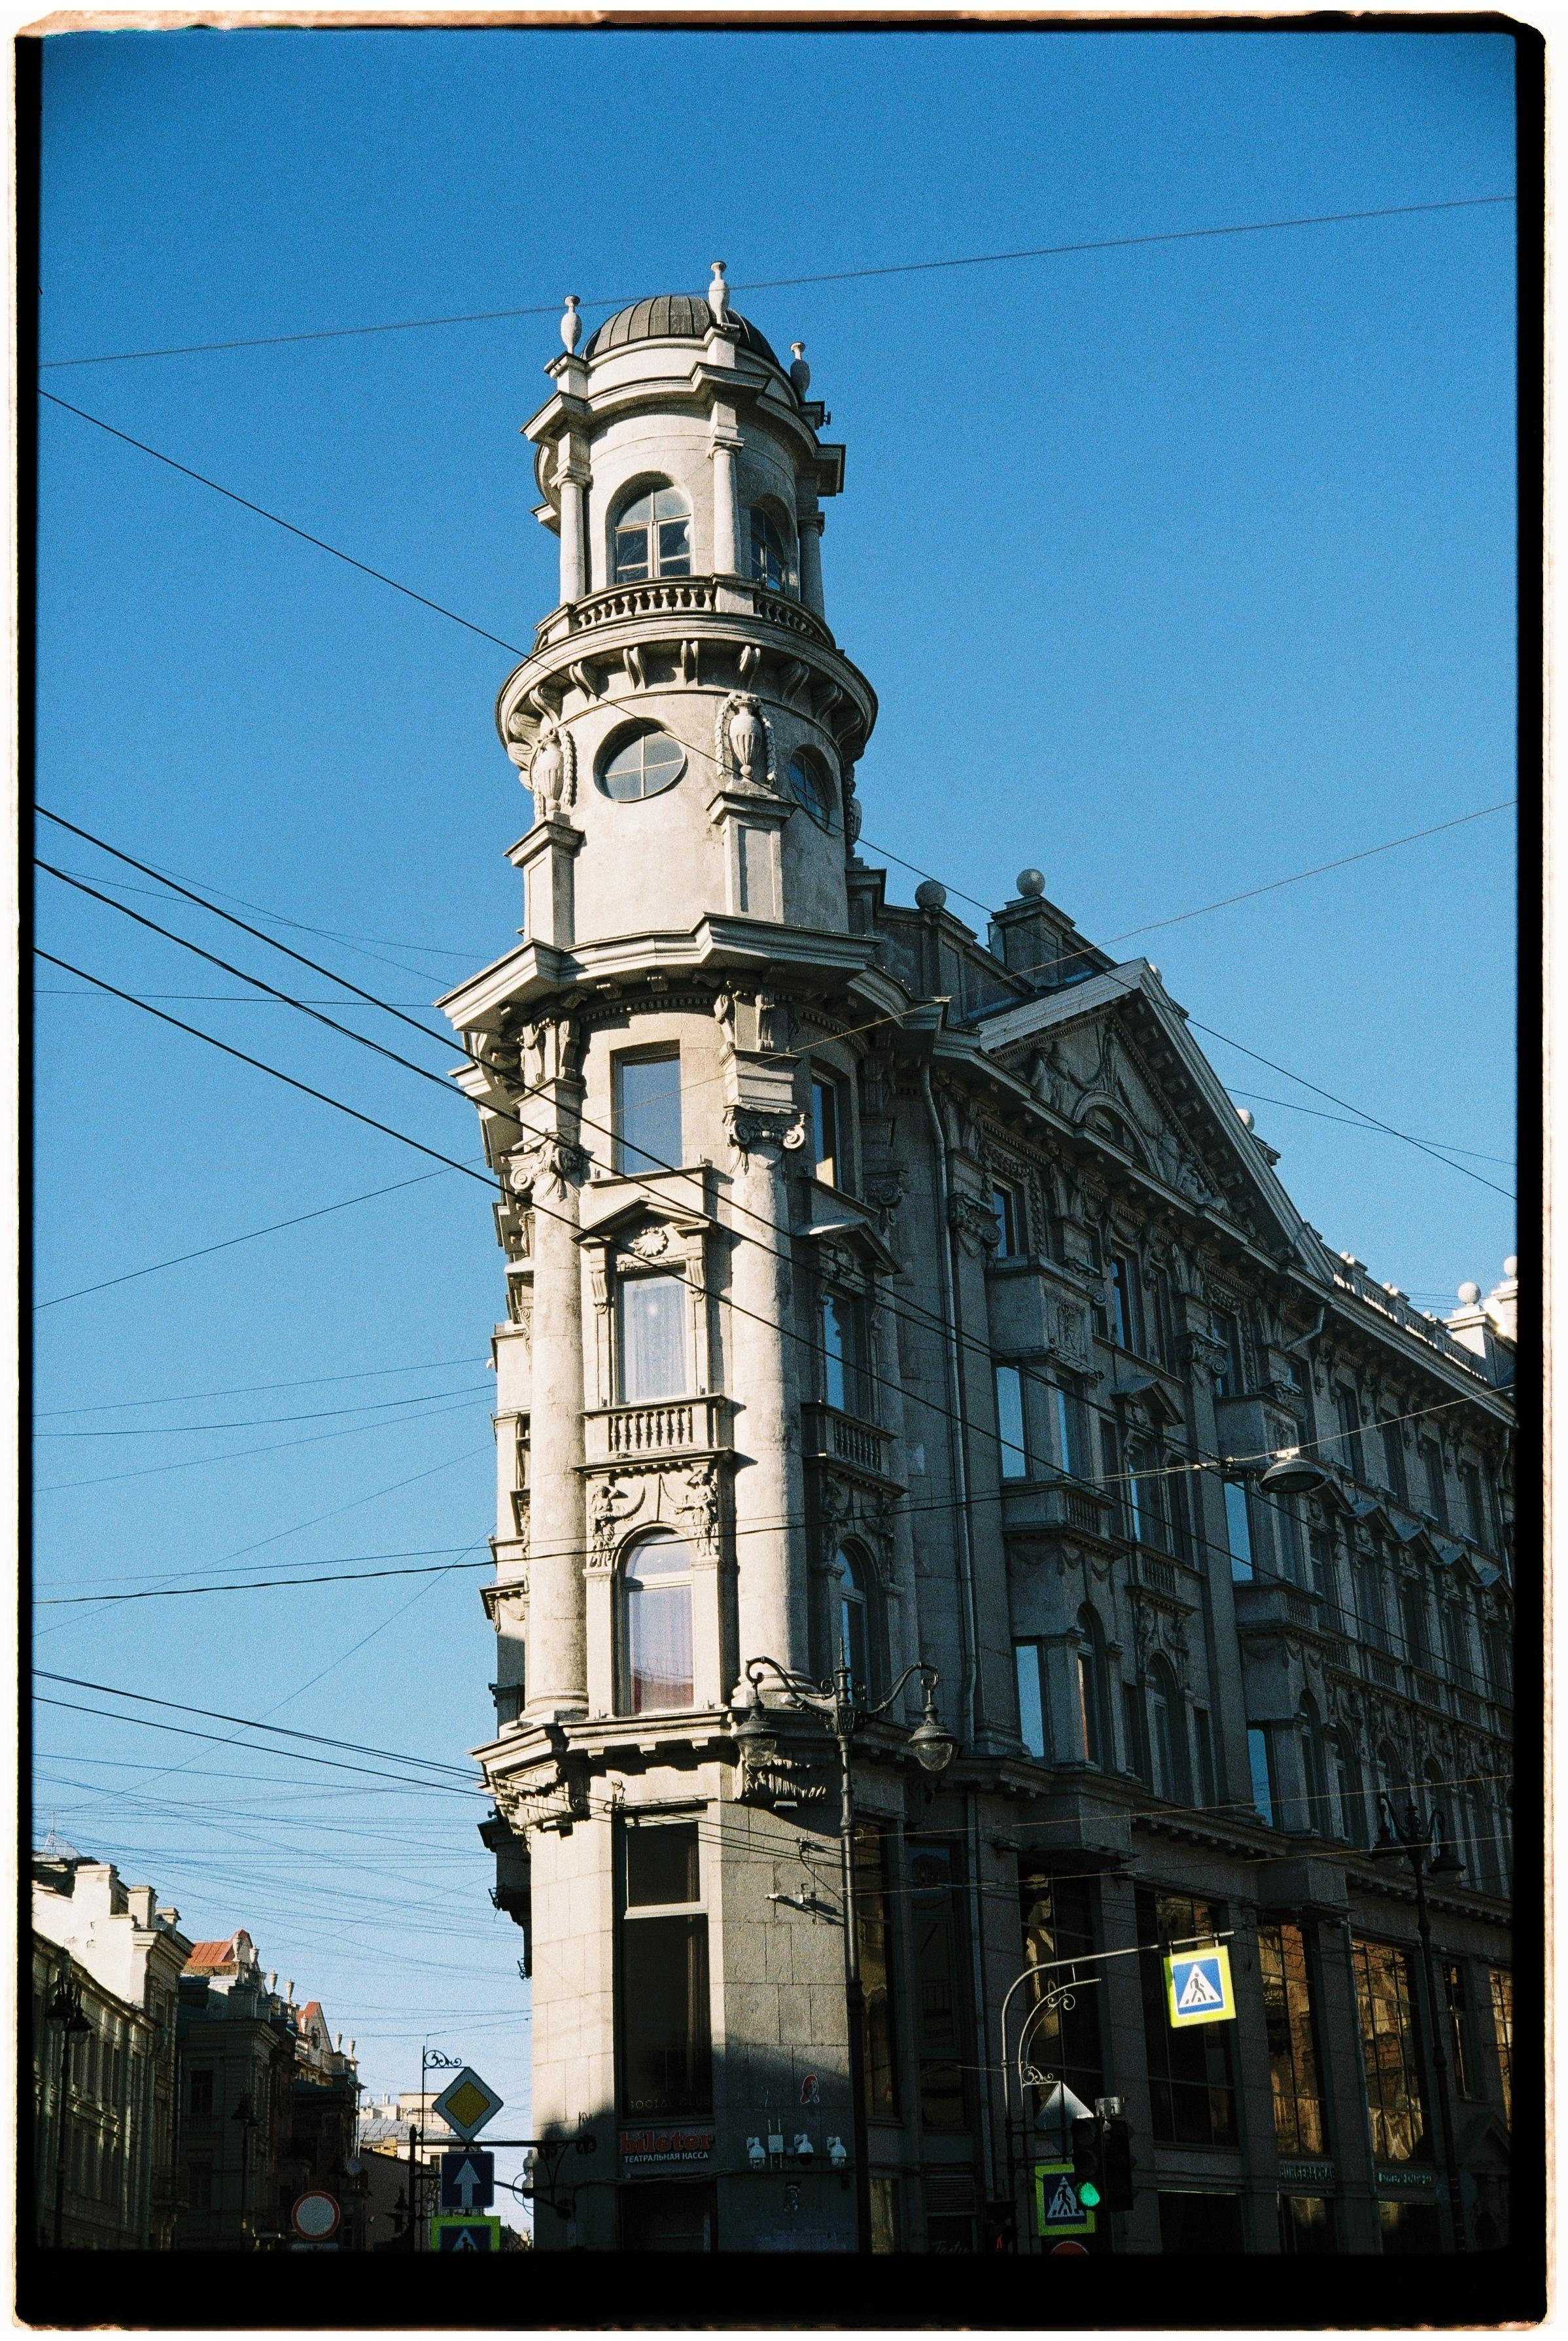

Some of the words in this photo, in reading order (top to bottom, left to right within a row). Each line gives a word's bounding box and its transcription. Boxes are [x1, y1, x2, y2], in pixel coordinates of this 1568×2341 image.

[631, 2099, 674, 2110] SOCIAL
[619, 2130, 713, 2155] bileter
[624, 2153, 680, 2163] ТЕАТРАЛЬНАЯ
[682, 2151, 708, 2160] КАССА
